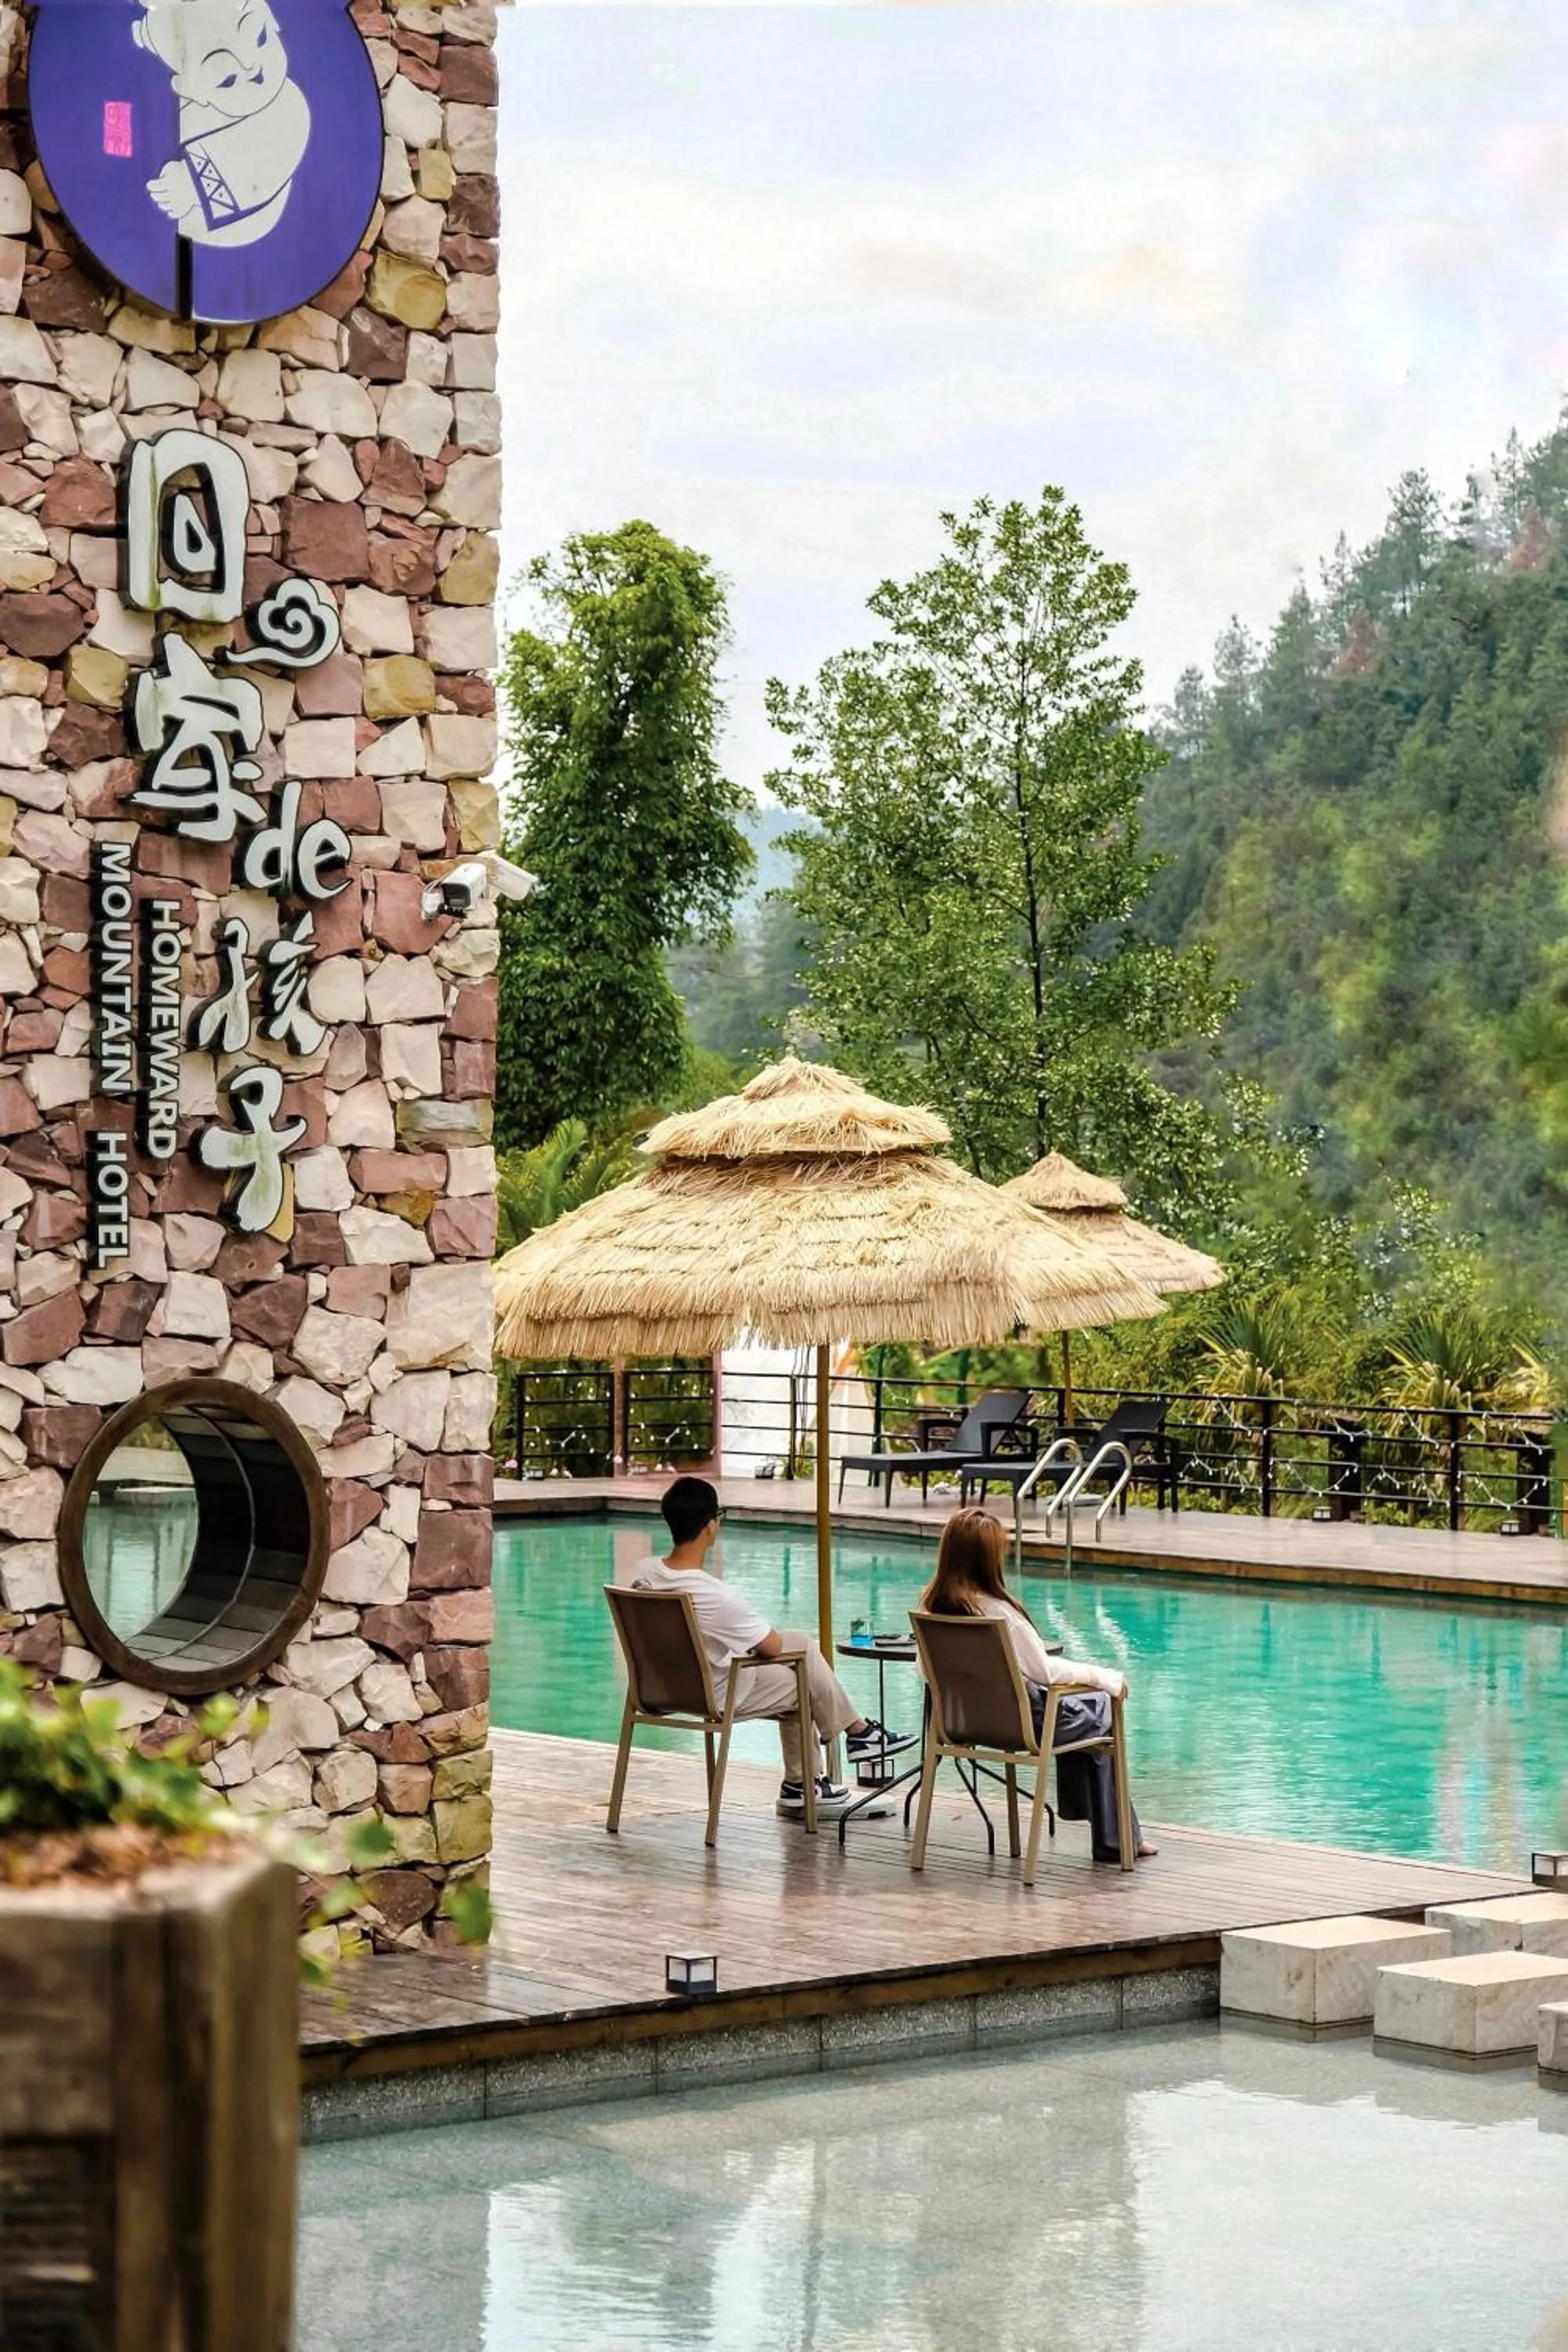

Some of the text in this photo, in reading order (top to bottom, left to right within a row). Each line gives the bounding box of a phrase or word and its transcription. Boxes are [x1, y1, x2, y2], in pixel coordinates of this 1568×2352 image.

[96, 842, 132, 1269] MOUNTAIN HOTEL
[147, 899, 180, 1160] HOMEWARD
